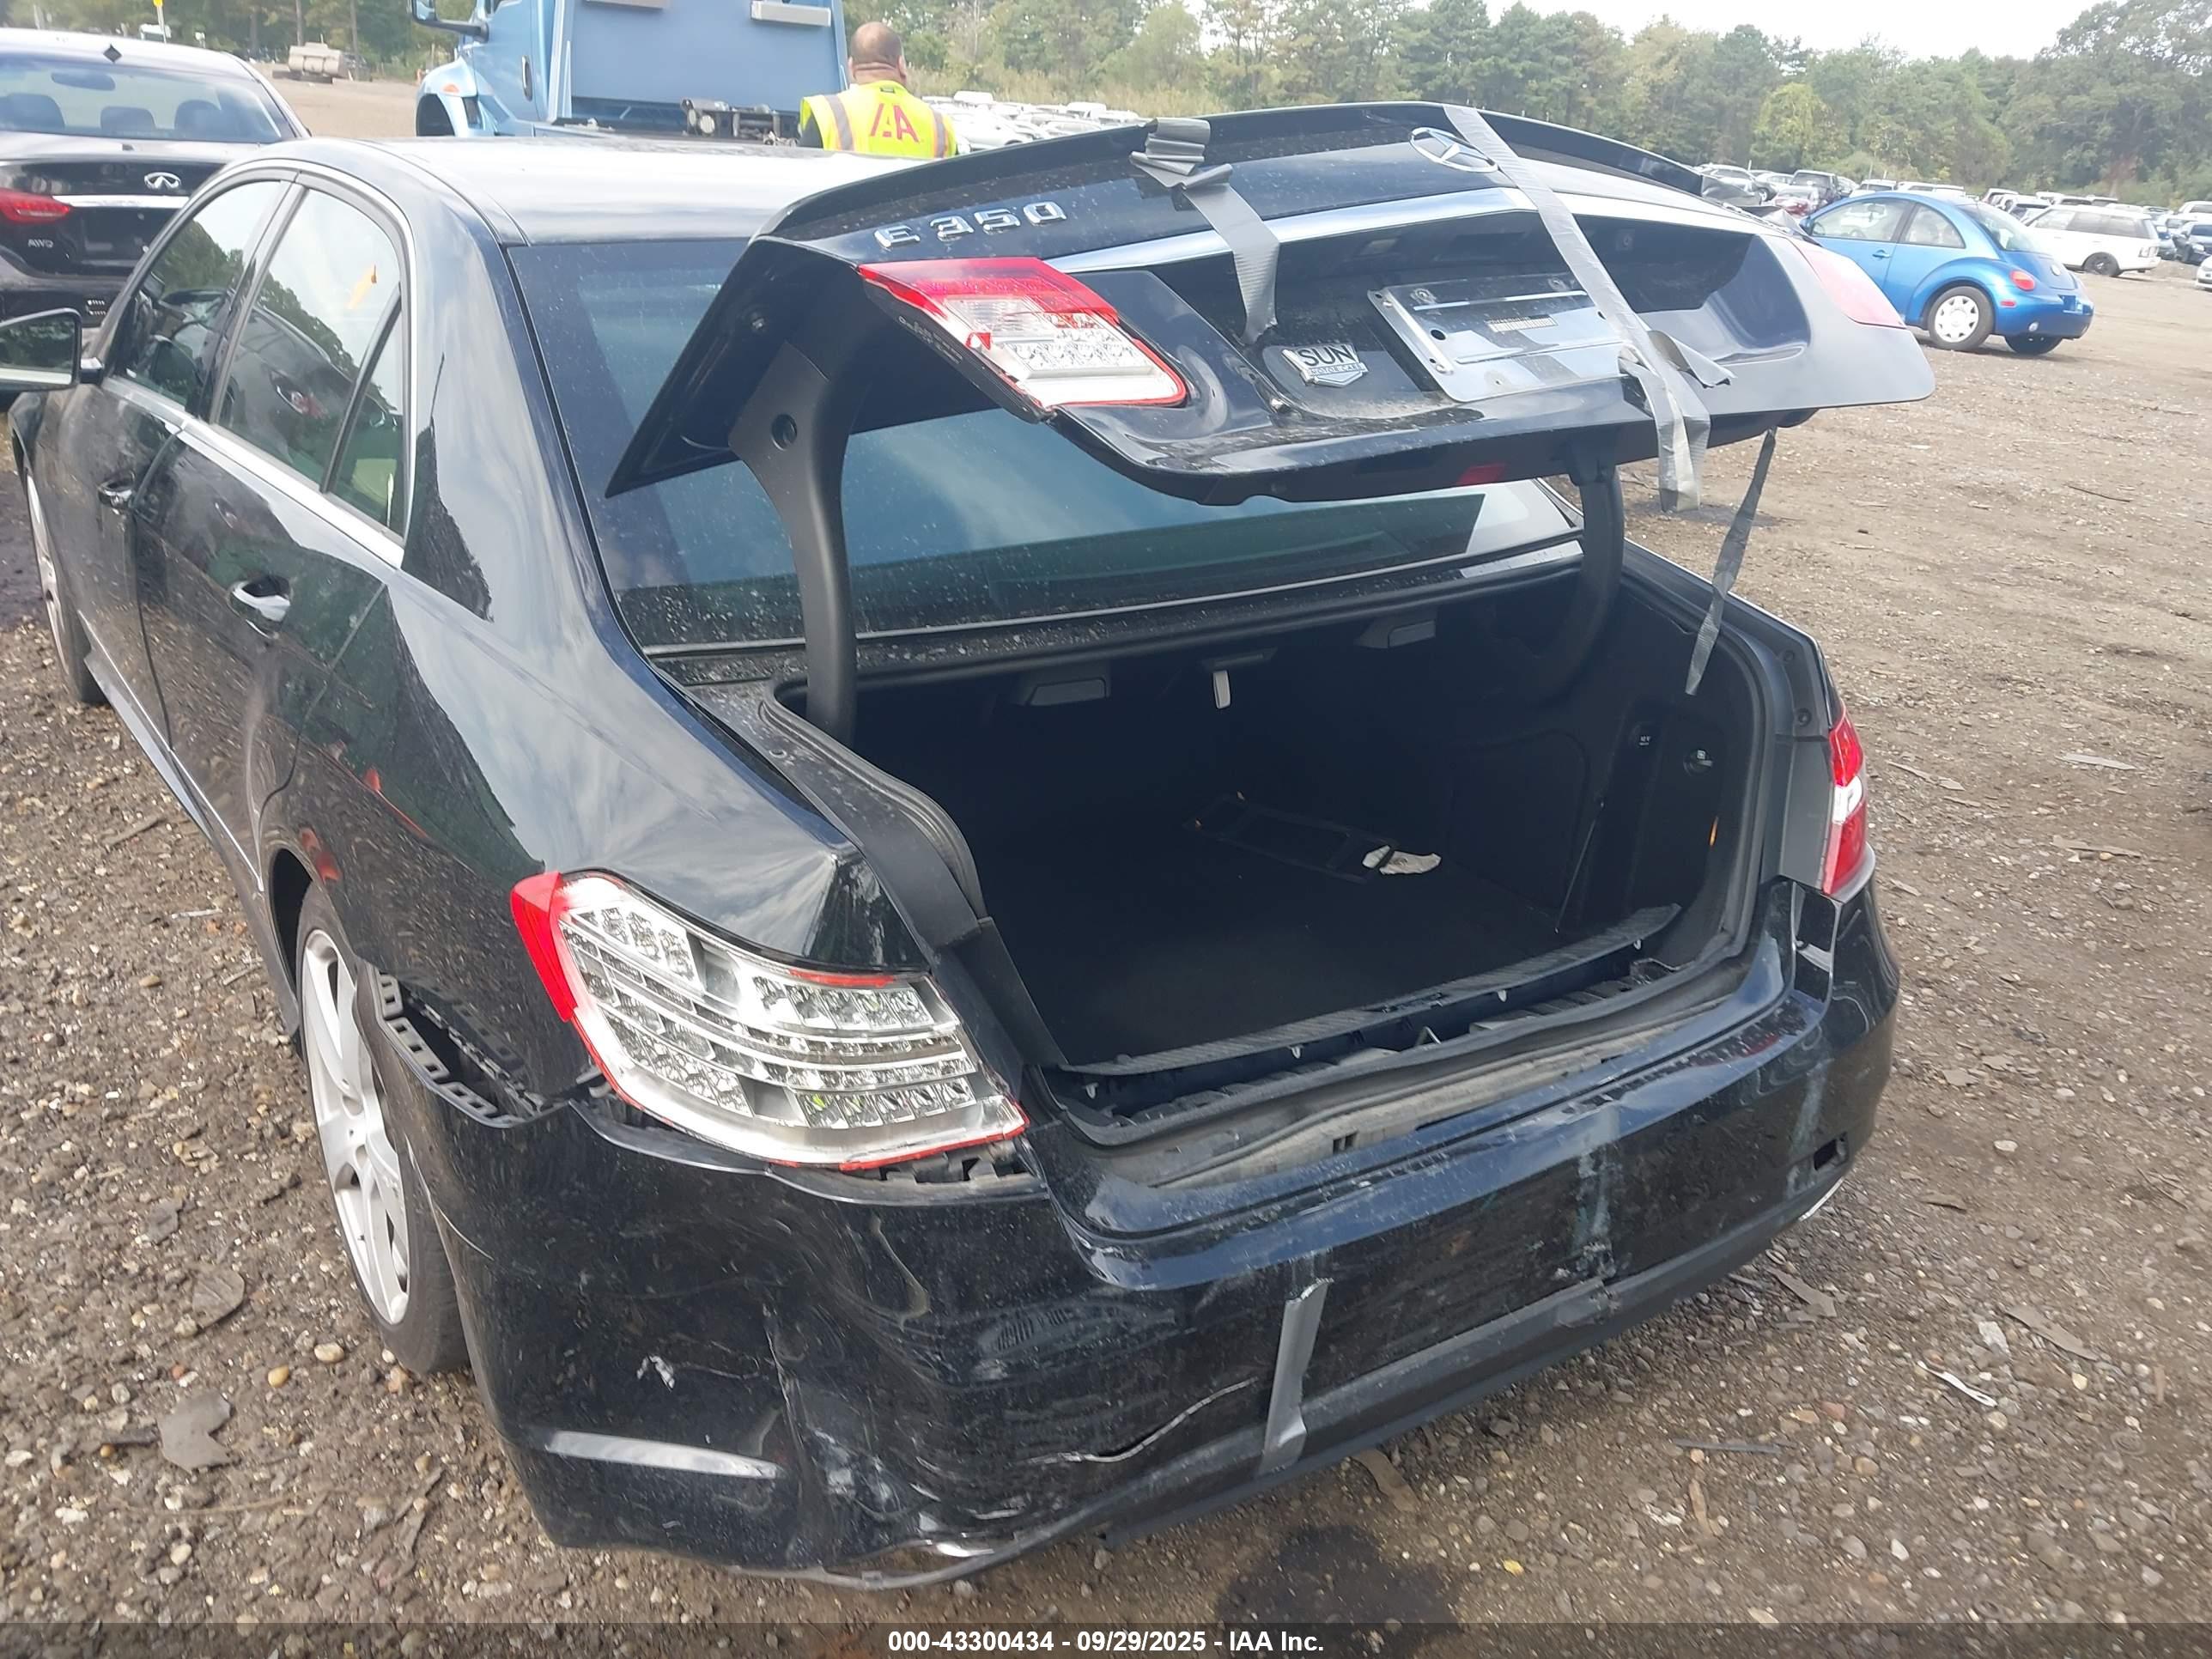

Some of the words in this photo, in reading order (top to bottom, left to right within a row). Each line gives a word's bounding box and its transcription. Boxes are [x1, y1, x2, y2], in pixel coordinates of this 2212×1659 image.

[873, 225, 921, 248] E
[930, 201, 1066, 238] 350
[27, 238, 54, 248] AWD
[1297, 344, 1356, 367] SUN
